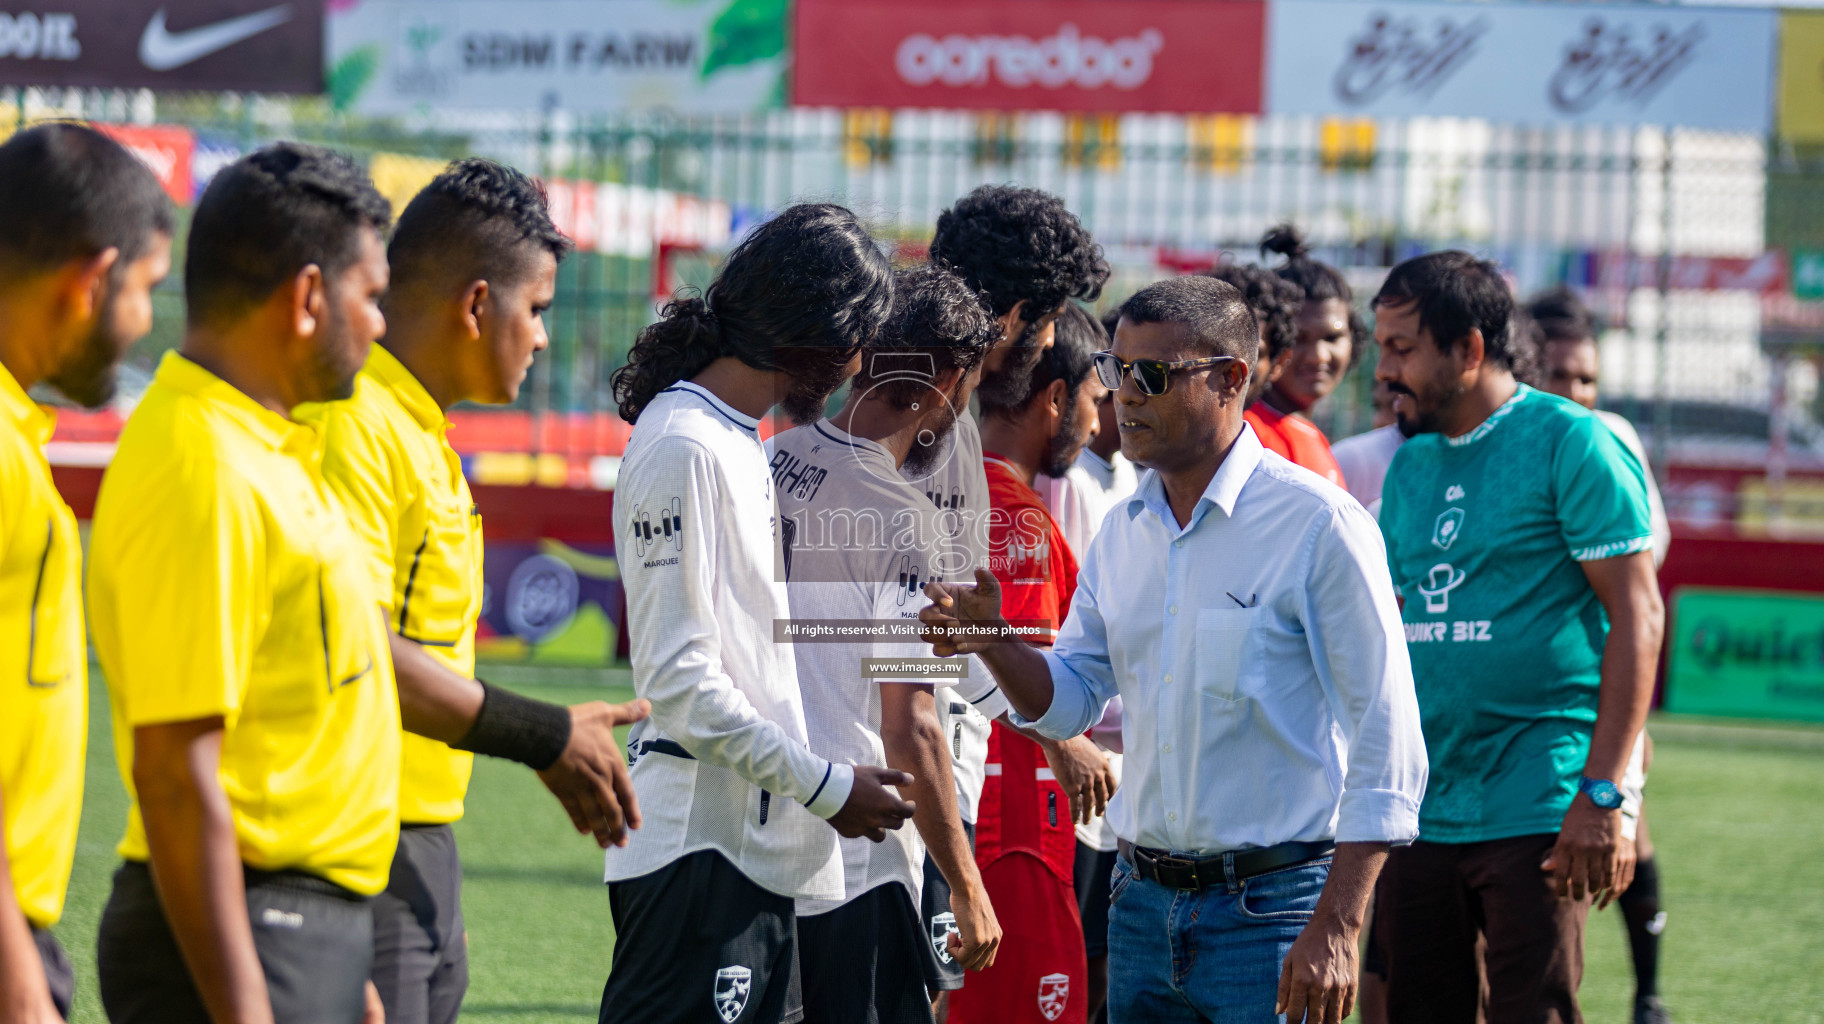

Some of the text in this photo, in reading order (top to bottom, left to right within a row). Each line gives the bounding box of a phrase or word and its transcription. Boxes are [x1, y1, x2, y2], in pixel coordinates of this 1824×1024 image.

[461, 31, 696, 71] SDM FARM
[896, 24, 1162, 88] ooredoo
[644, 557, 679, 568] MARQUEE
[1453, 620, 1493, 642] BIZ
